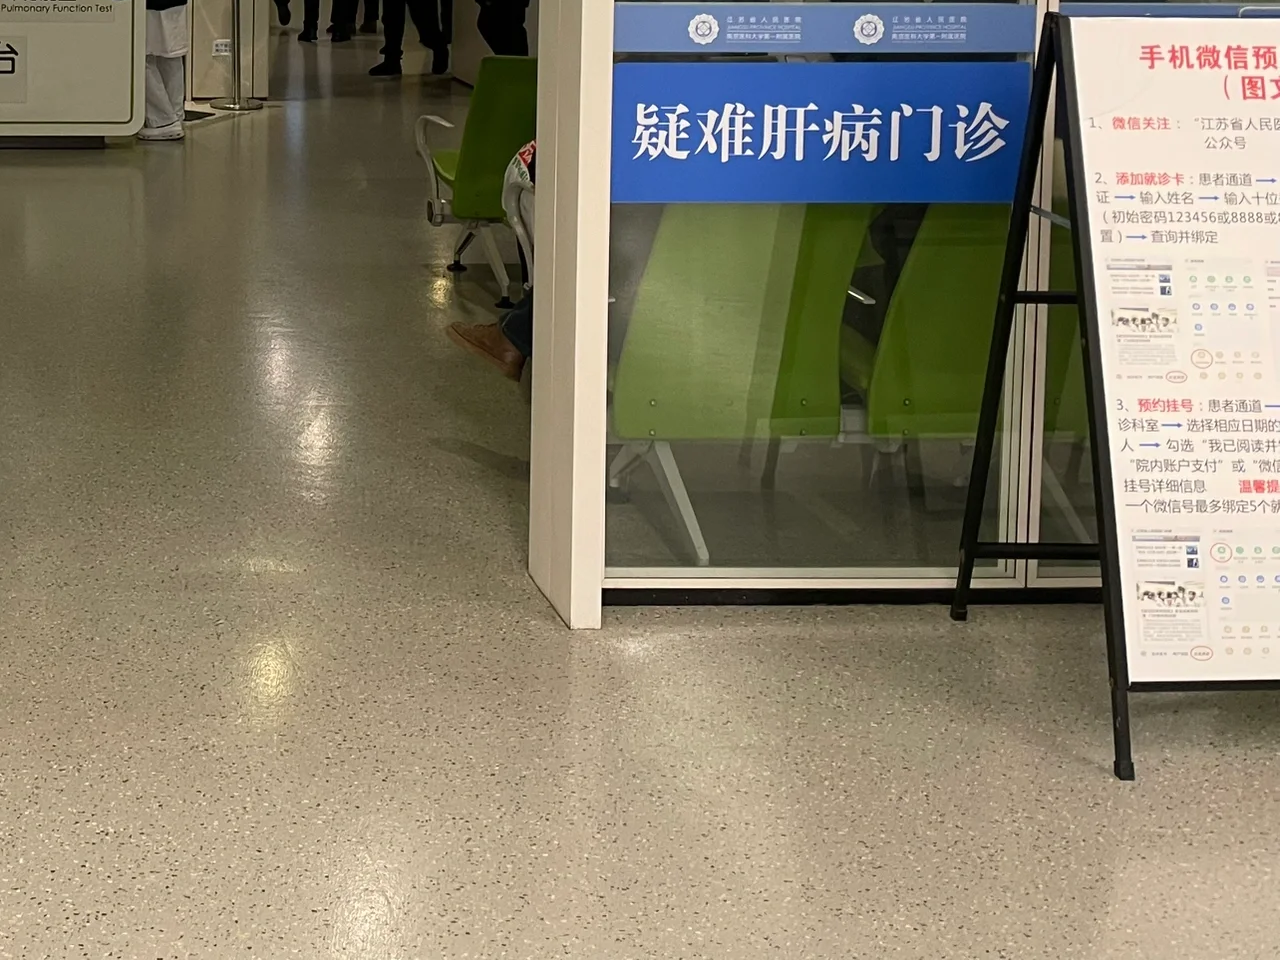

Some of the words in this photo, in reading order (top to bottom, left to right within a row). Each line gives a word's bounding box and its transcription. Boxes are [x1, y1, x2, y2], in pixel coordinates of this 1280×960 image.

[1, 3, 50, 14] Pulmonary
[53, 3, 93, 13] Function
[95, 4, 112, 13] Test
[1139, 44, 1278, 71] 手机微信预
[632, 101, 1010, 164] 疑难肝病门诊
[1205, 137, 1246, 150] 公众号
[1096, 191, 1111, 204] 证
[1139, 191, 1194, 205] 输入姓名
[1151, 230, 1219, 244] 查询并绑定
[1118, 418, 1160, 432] 诊科室
[1121, 438, 1134, 452] 人
[1124, 479, 1206, 493] 挂号详细信息
